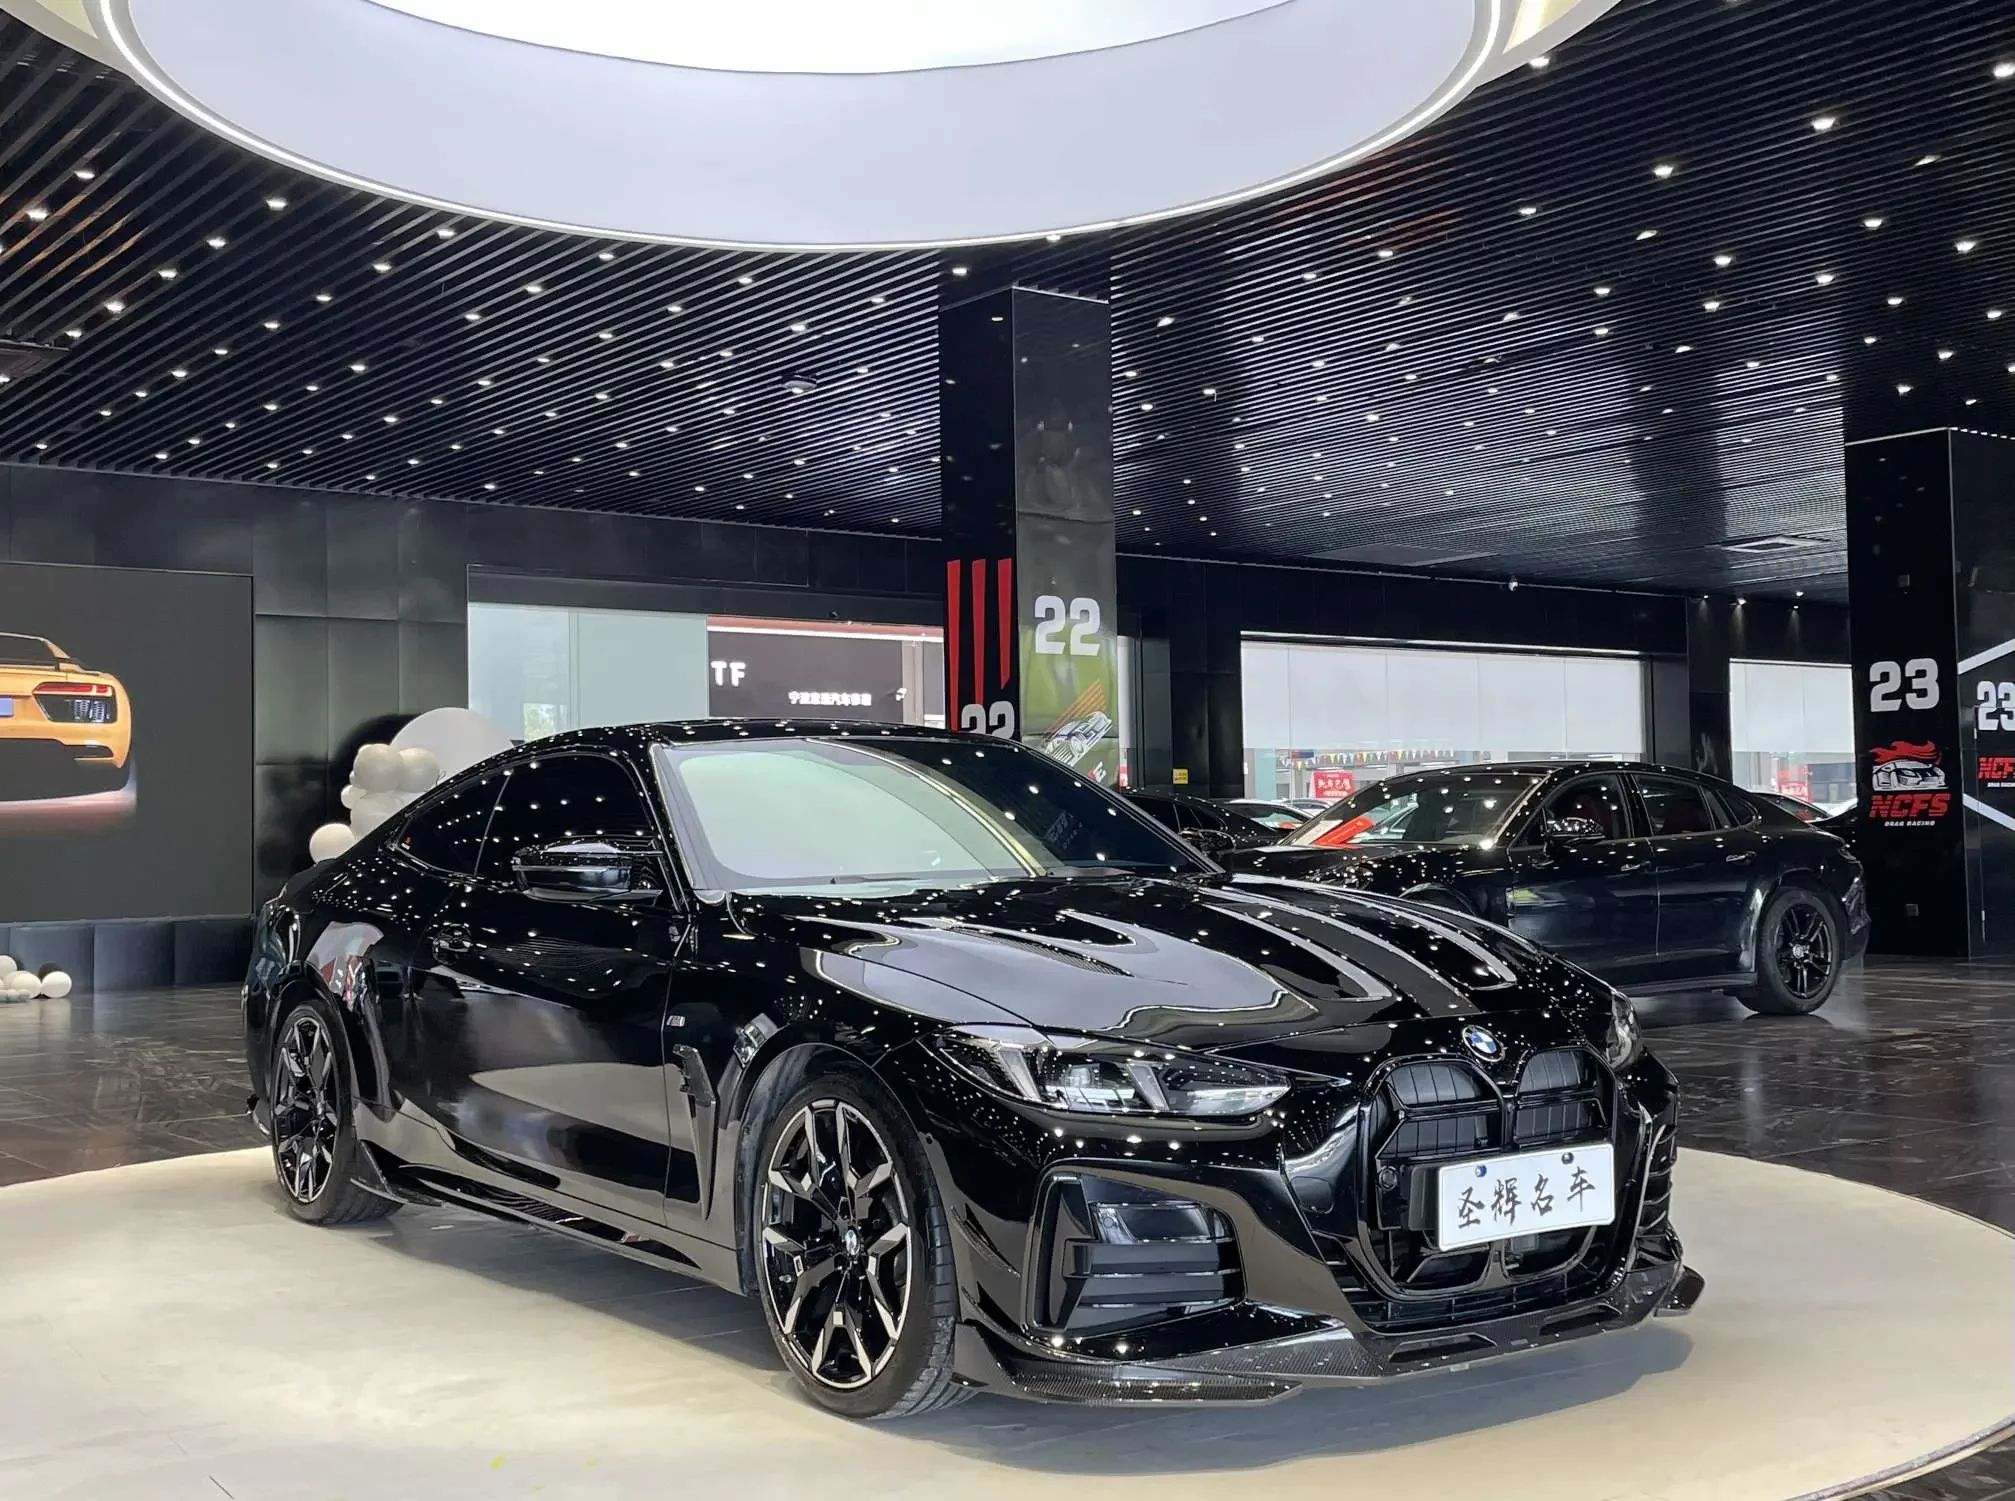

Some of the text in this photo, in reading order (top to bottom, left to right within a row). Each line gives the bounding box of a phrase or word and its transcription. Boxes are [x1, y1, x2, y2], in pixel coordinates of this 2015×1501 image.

[1033, 594, 1101, 656] 22
[1869, 657, 1940, 713] 23
[1976, 680, 2015, 731] 23
[1977, 756, 2015, 779] NCF
[1869, 793, 1952, 818] NCFS
[1457, 1166, 1596, 1229] 圣辉名车
